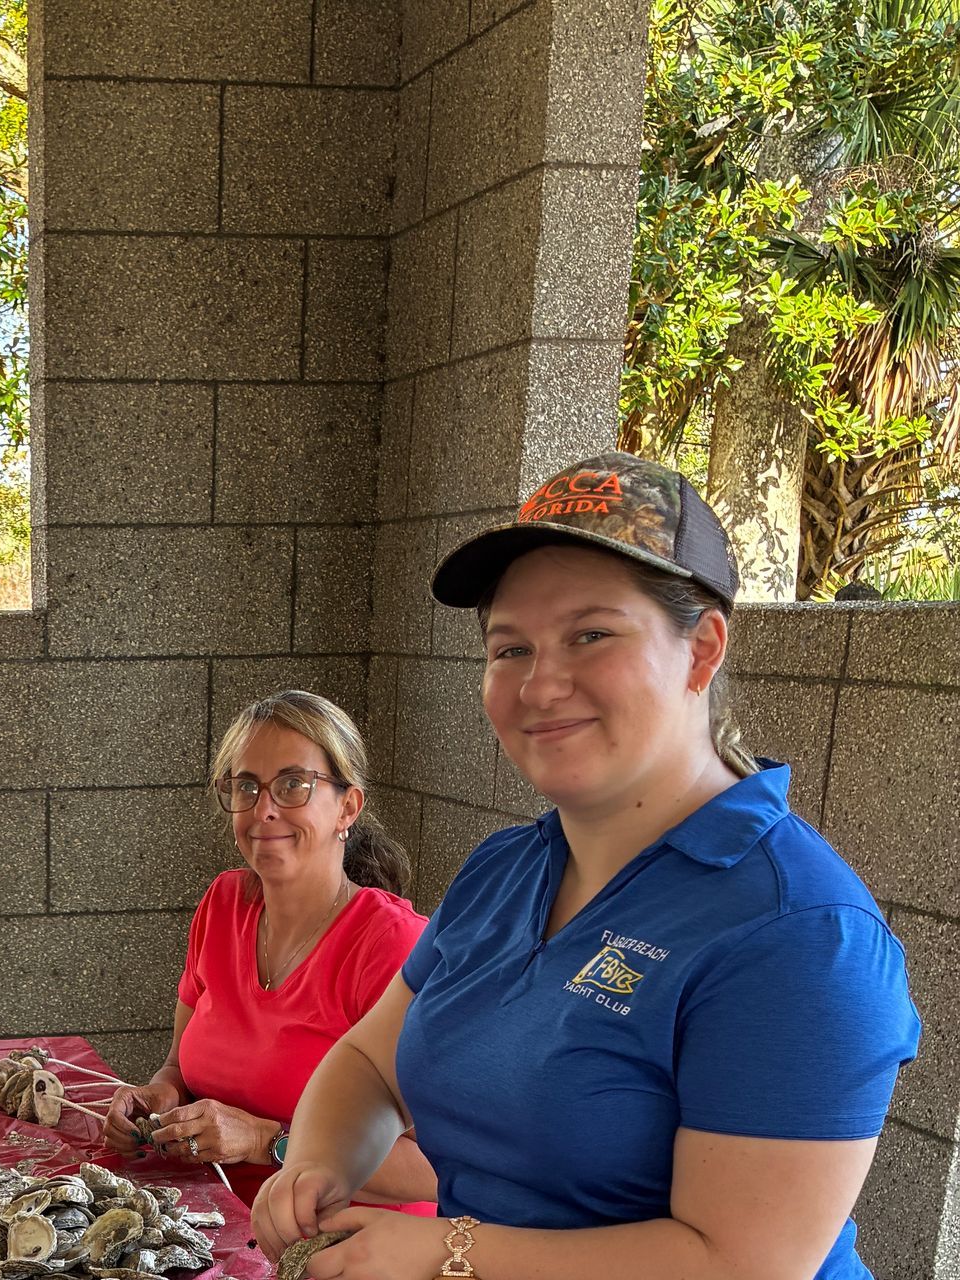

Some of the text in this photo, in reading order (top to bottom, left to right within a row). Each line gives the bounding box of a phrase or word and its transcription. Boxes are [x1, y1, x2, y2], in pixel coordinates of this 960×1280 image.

[545, 472, 623, 498] CCA
[632, 941, 670, 961] BEACH
[562, 980, 631, 1016] YACHT CLUB
